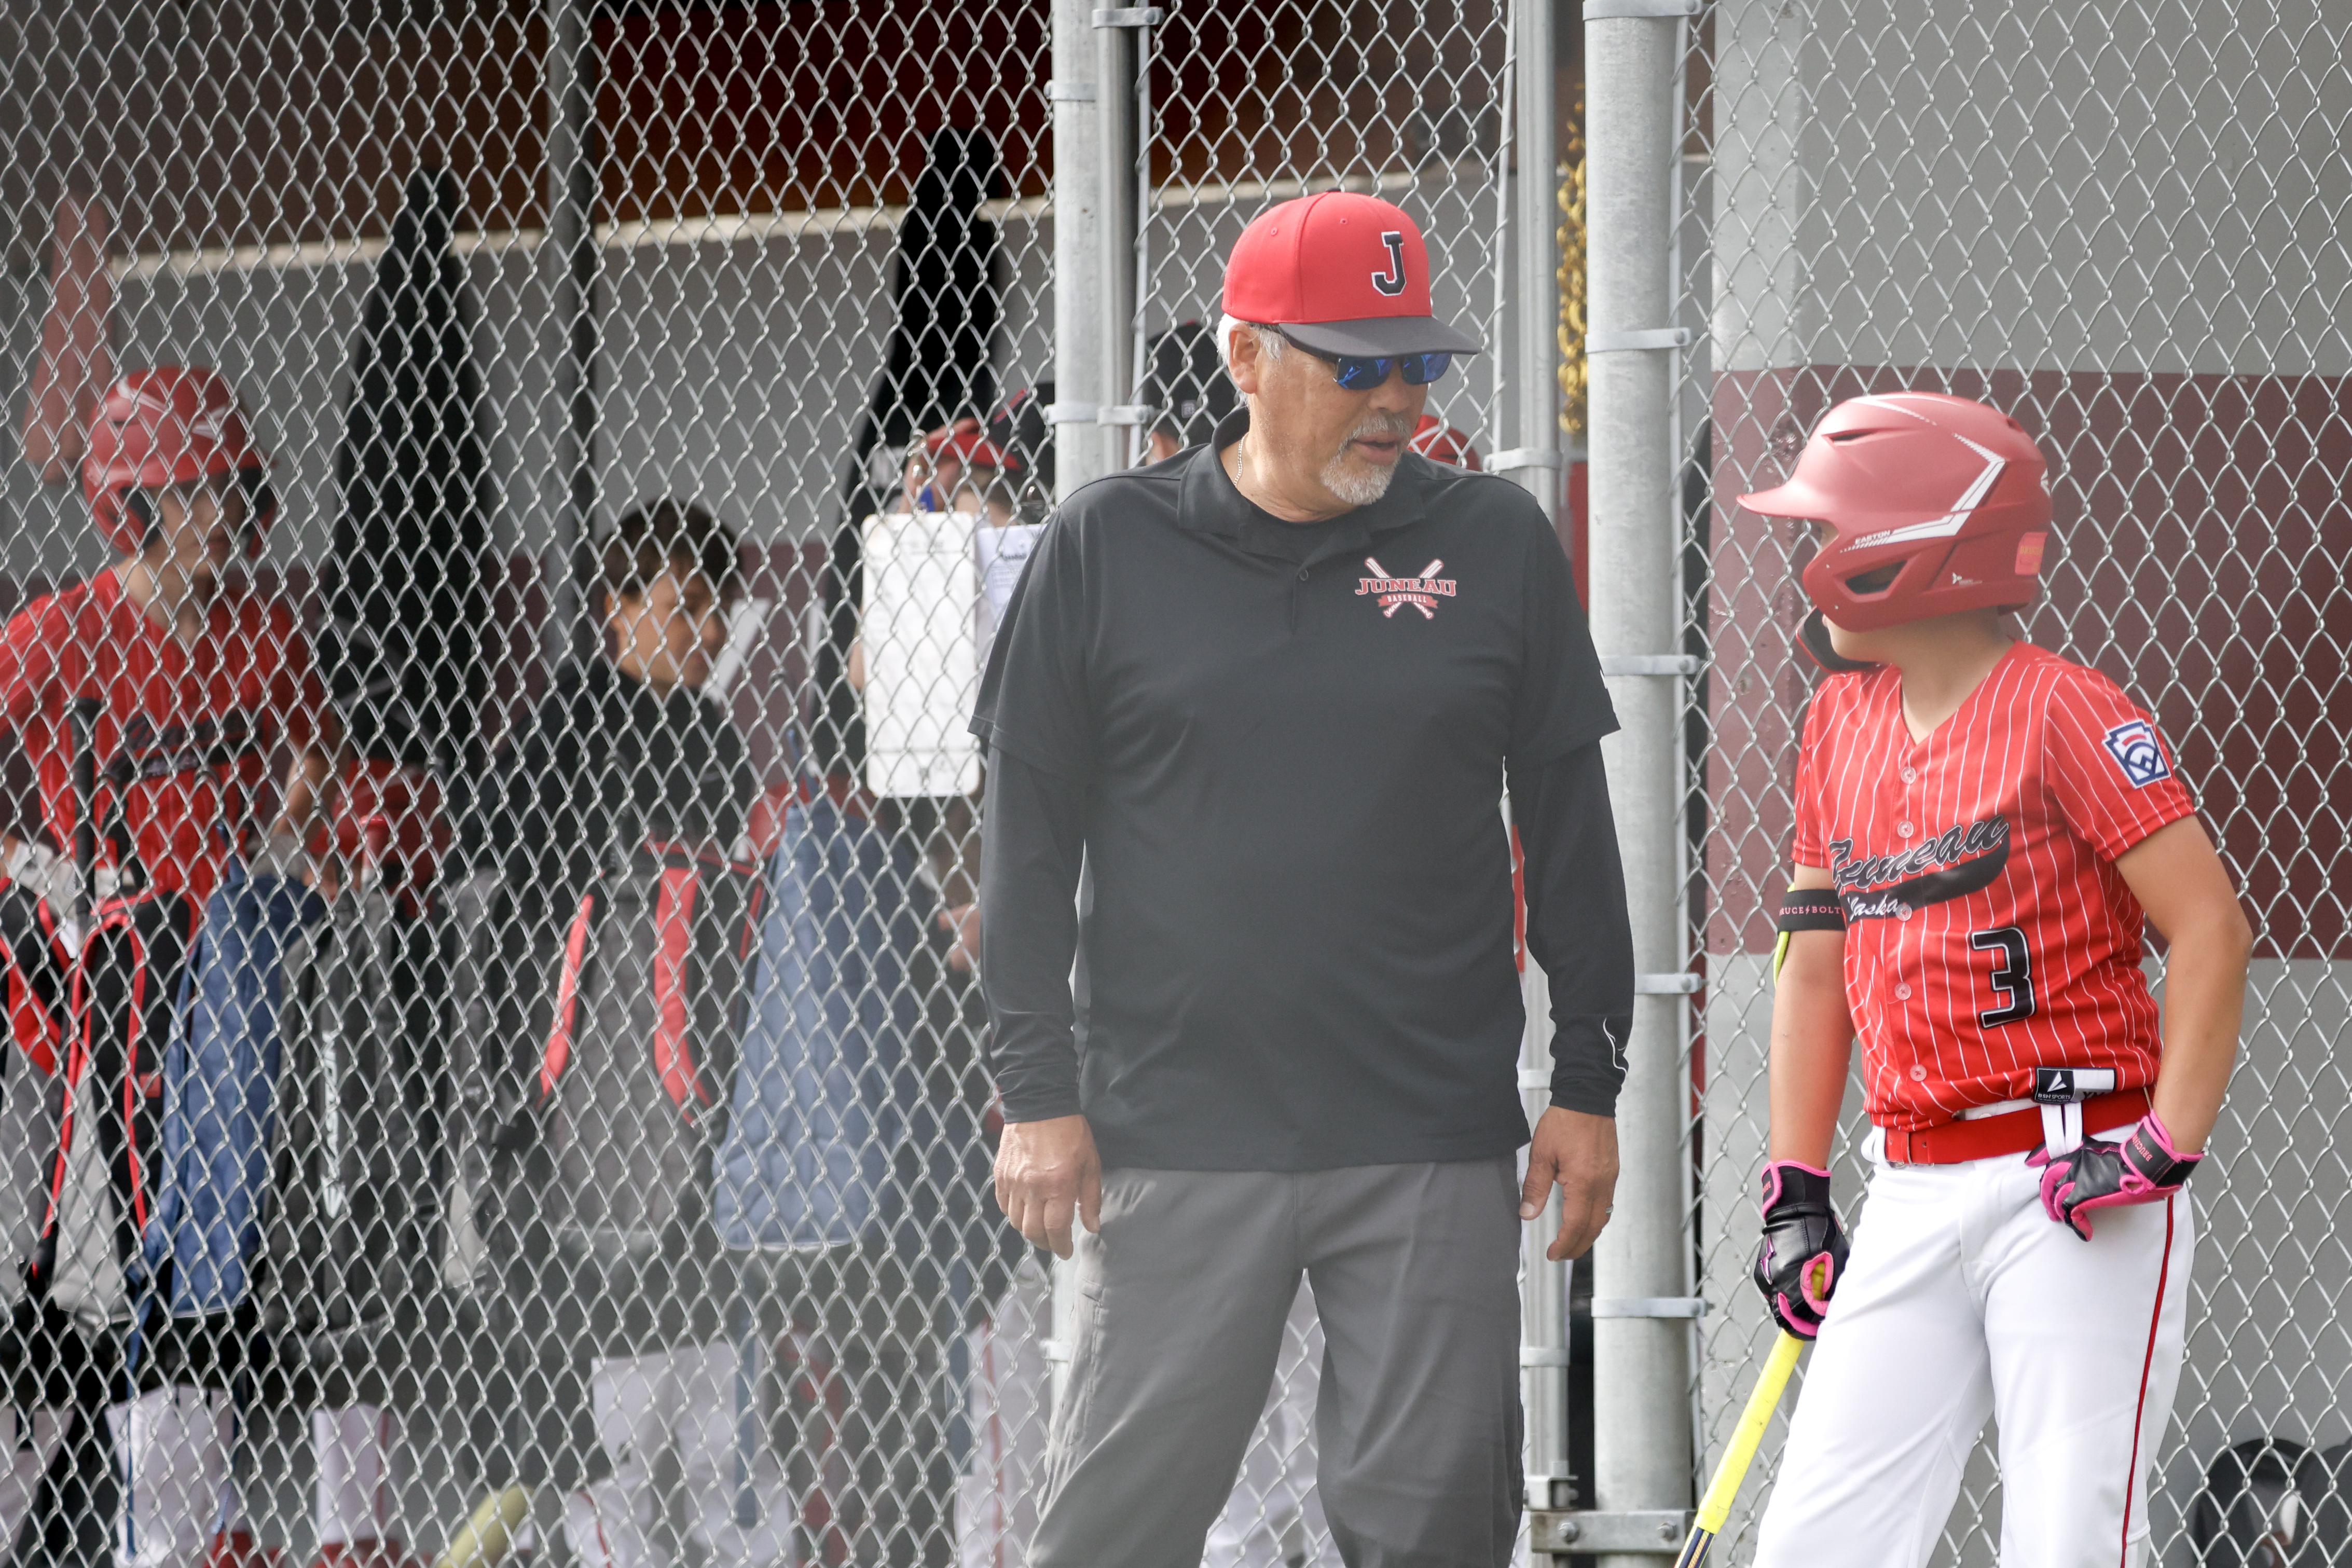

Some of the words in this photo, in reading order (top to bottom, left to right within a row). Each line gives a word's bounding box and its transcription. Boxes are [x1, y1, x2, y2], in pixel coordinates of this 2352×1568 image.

[1371, 231, 1407, 296] J
[1355, 578, 1457, 597] JUNEAU
[1387, 595, 1427, 603] BASEBALL
[1971, 926, 2037, 1029] 3
